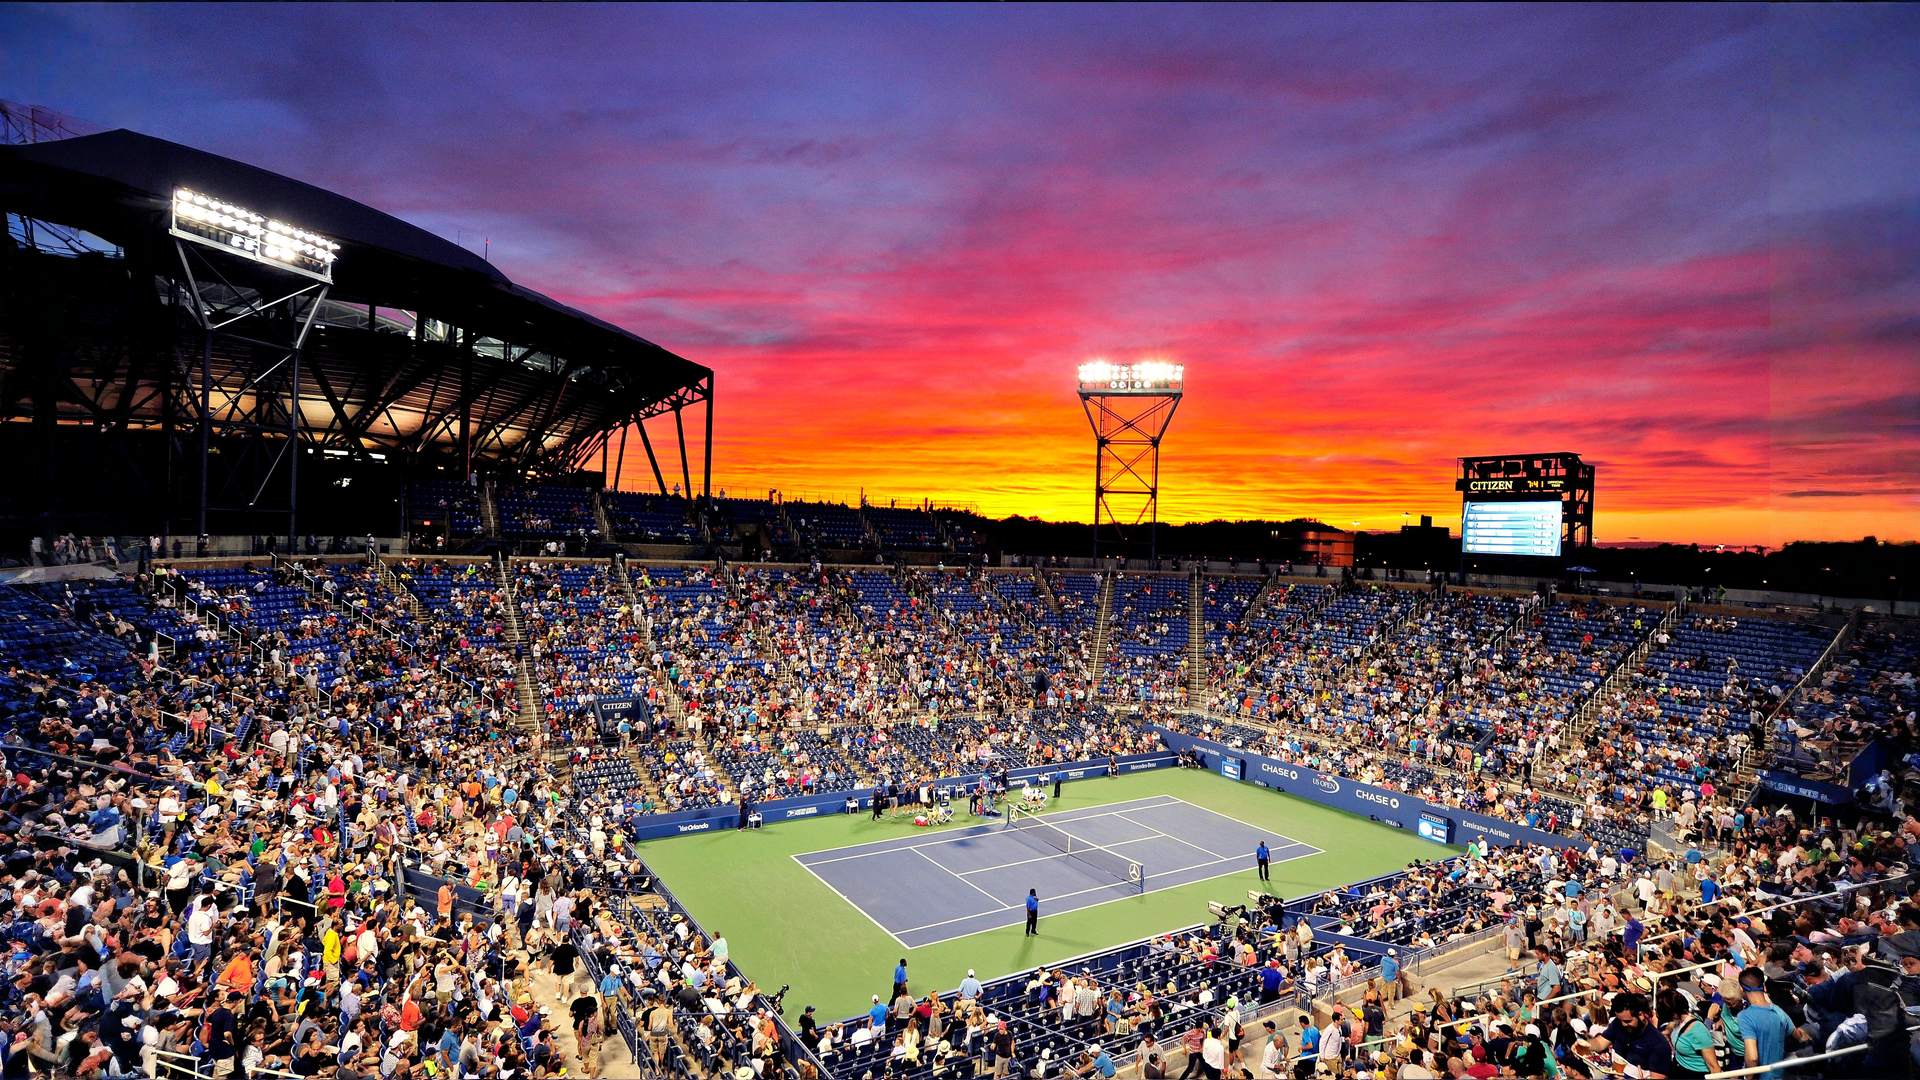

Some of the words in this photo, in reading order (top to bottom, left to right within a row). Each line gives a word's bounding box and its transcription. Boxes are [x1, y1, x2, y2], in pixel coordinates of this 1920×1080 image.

[1470, 481, 1513, 490] CITIZEN
[602, 702, 632, 710] CITIZEN
[1261, 763, 1289, 778] CHASE
[1312, 778, 1319, 786] US
[1320, 780, 1335, 790] OPEN
[1355, 789, 1389, 806] CHASE
[1385, 819, 1396, 827] POLO
[1421, 813, 1444, 824] CITIZEN
[1462, 820, 1488, 833] Emirates
[1489, 827, 1511, 839] Airline
